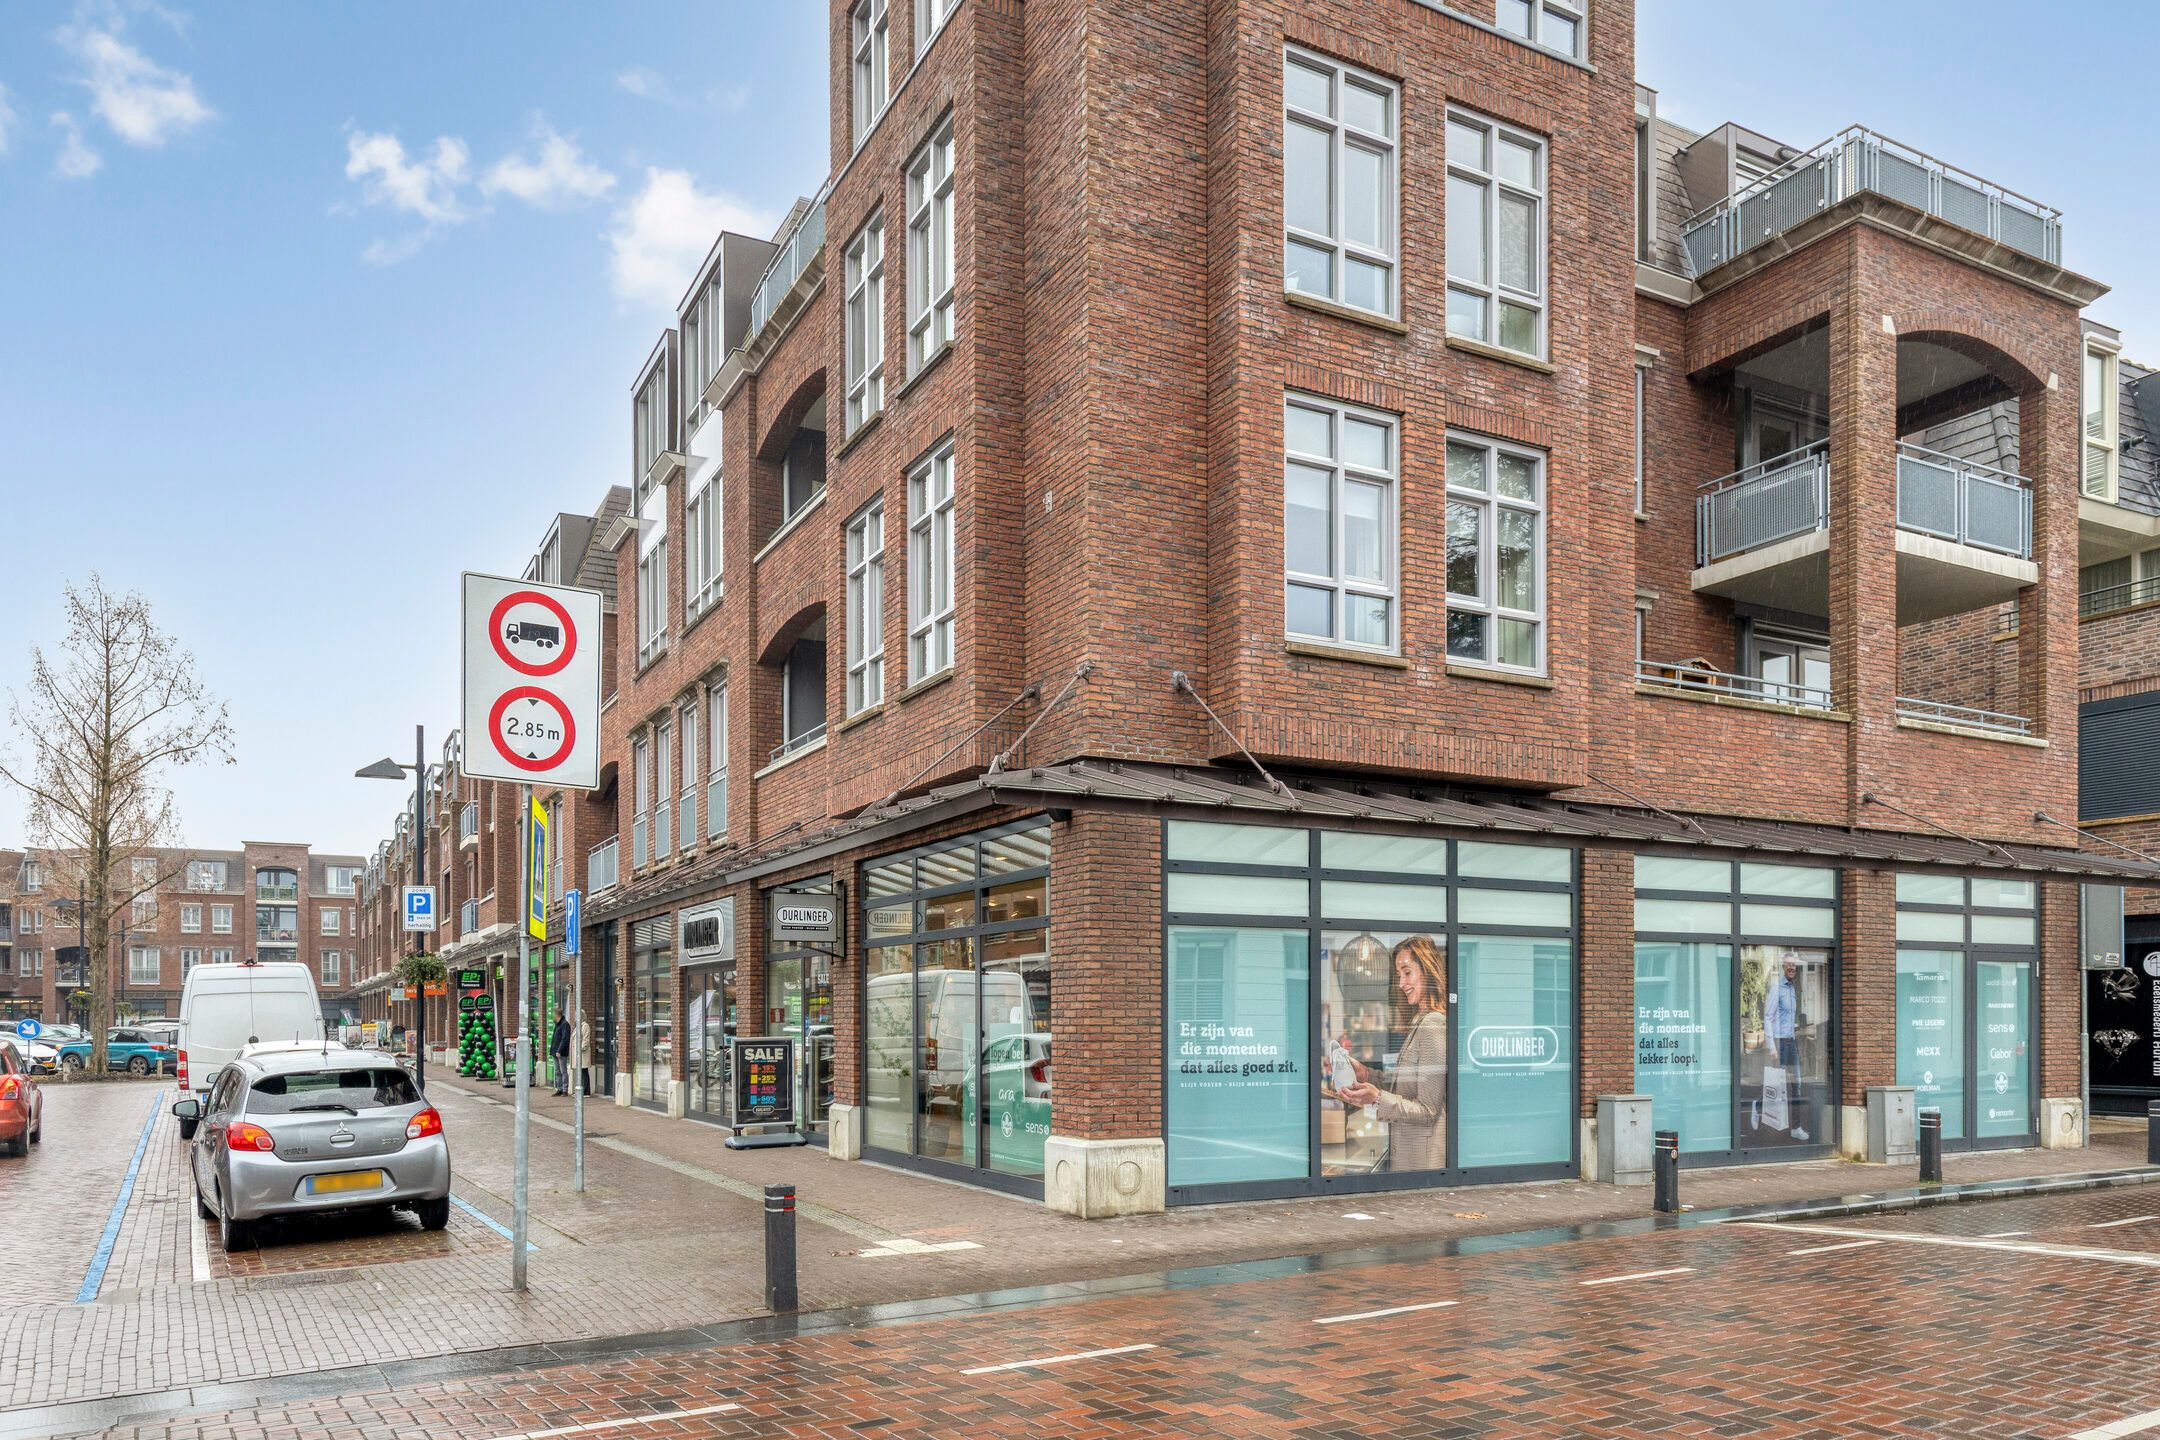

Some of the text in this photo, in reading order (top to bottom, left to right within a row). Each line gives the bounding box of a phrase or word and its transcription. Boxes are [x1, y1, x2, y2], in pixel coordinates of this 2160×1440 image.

[507, 717, 560, 741] 2.85 m
[413, 895, 427, 912] P
[782, 909, 828, 922] DURLINGER
[461, 972, 481, 981] EP:
[1910, 995, 1930, 1003] MARCO
[1639, 1007, 1690, 1021] Er zijn van
[1180, 1022, 1253, 1040] Er zijn van
[1639, 1022, 1706, 1033] die momenten
[1180, 1041, 1278, 1055] die momenten
[1481, 1036, 1545, 1057] DURLINGER
[1639, 1037, 1679, 1048] dat alles
[744, 1048, 784, 1060] SALE
[1639, 1052, 1698, 1067] lekker loopt.
[1990, 1047, 2012, 1059] Gabor
[1180, 1060, 1298, 1077] dat alles goed zit.
[998, 1089, 1015, 1101] ara
